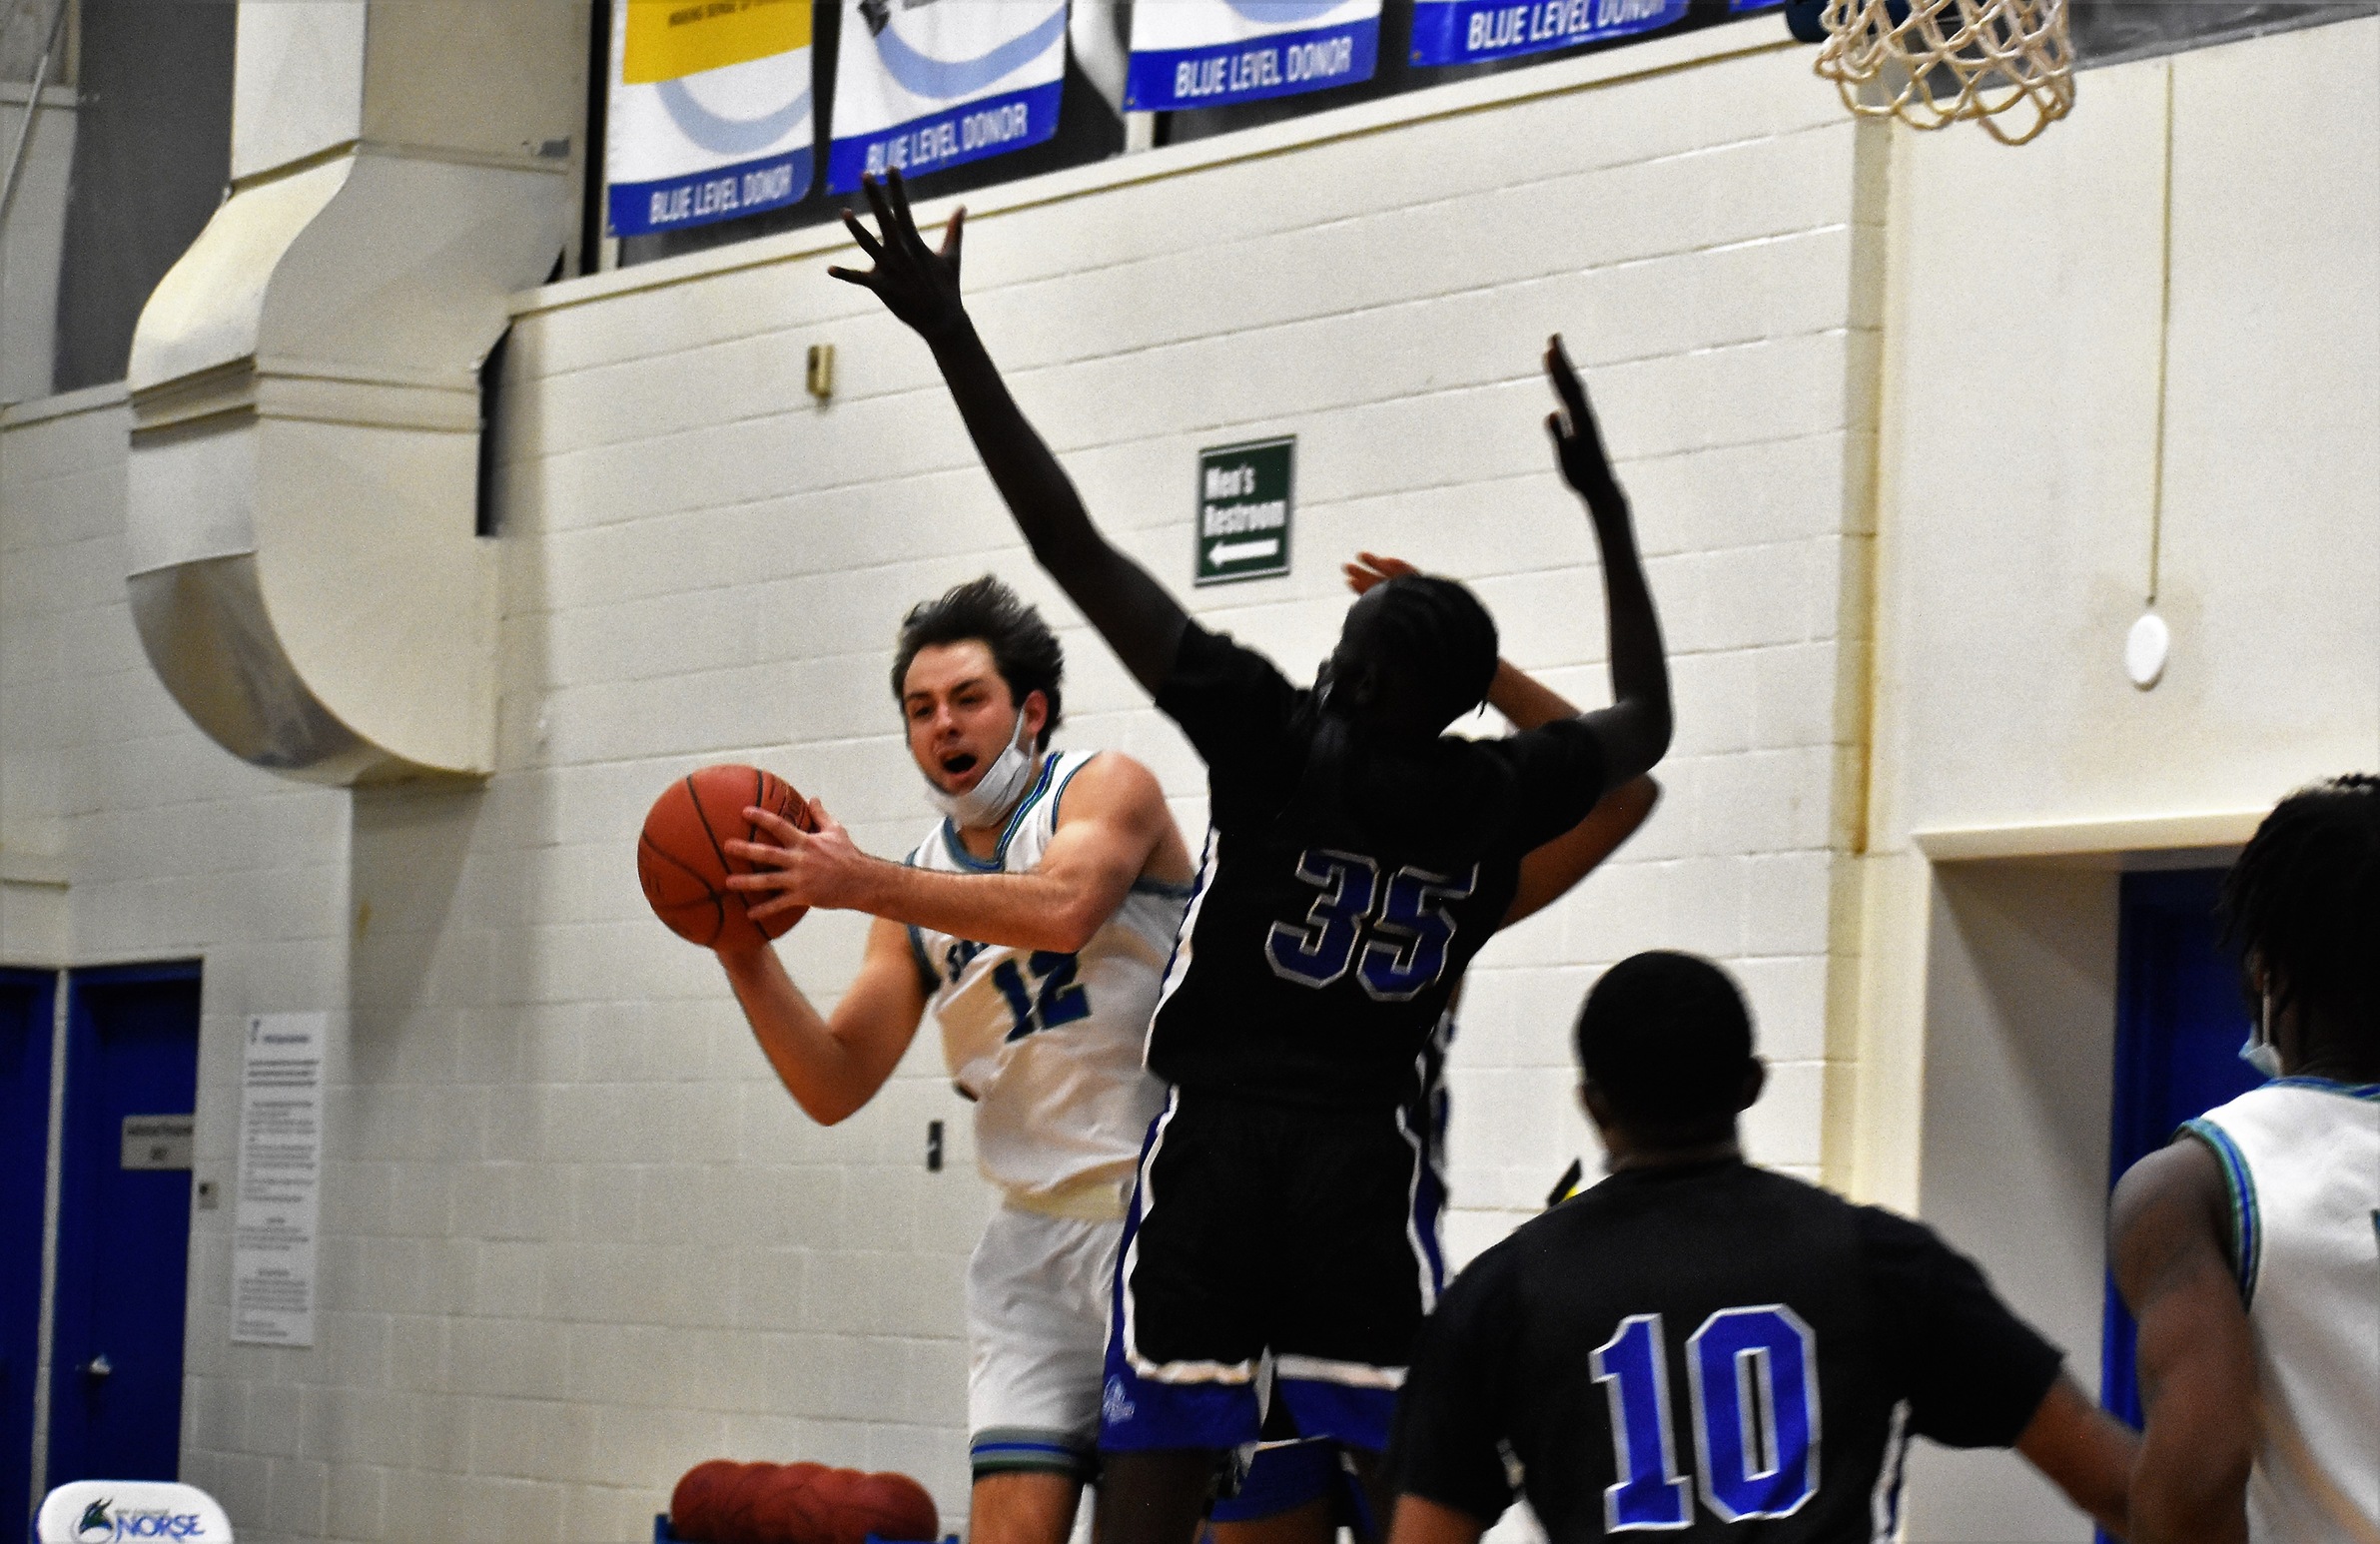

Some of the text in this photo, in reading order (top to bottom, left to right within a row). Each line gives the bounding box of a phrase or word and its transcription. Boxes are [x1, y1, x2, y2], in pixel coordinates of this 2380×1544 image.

[1468, 6, 1529, 50] BLUE
[1531, 0, 1591, 42] LEVEL
[1175, 36, 1353, 98] BLUE LEVEL DONOR
[866, 102, 1029, 176] BLUE LEVEL DONOR
[650, 163, 794, 224] BLUE LEVEL DONOR
[1203, 501, 1285, 537] Restroom
[1264, 849, 1480, 1001] 35
[992, 950, 1093, 1044] 12
[1588, 1302, 1823, 1535] 10
[115, 1513, 206, 1543] NORSE
